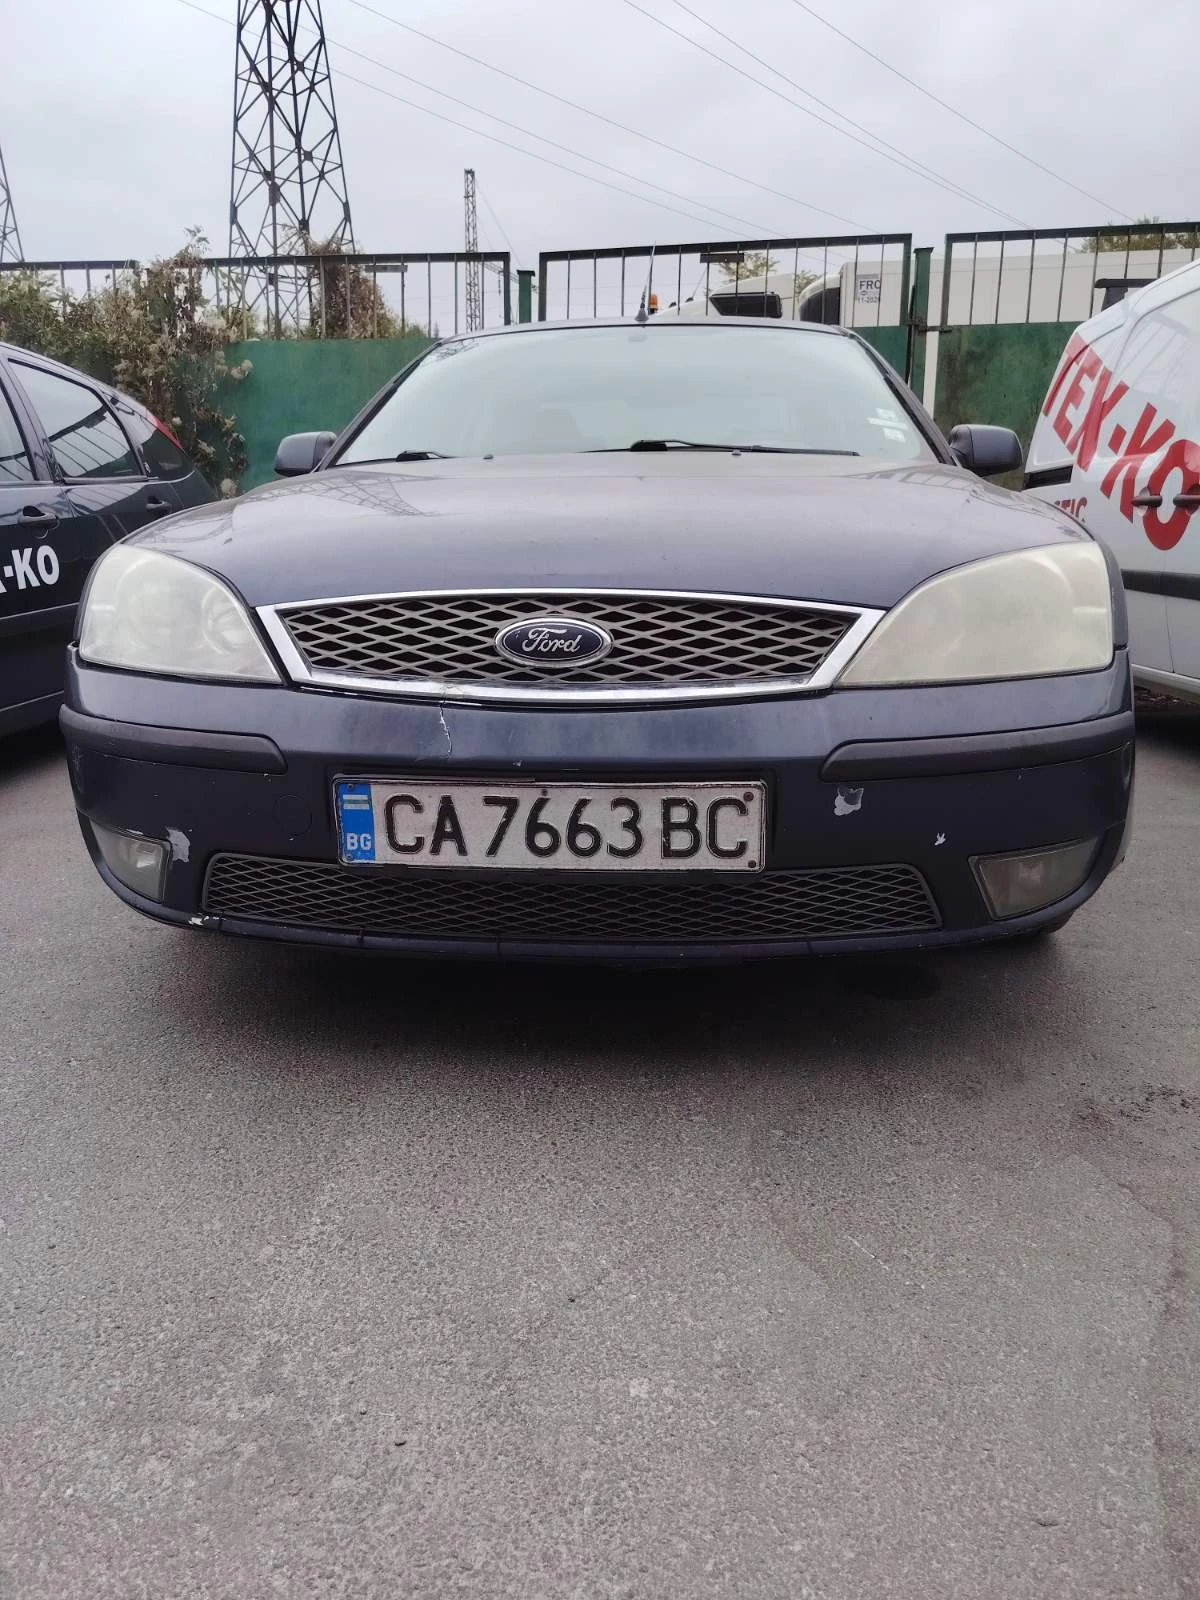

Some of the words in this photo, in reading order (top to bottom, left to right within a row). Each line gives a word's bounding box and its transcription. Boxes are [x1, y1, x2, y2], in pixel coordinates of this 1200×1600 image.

[521, 627, 582, 652] Ford
[384, 794, 468, 857] CA
[482, 794, 643, 859] 7663
[661, 796, 749, 860] BC
[346, 832, 372, 851] BG
